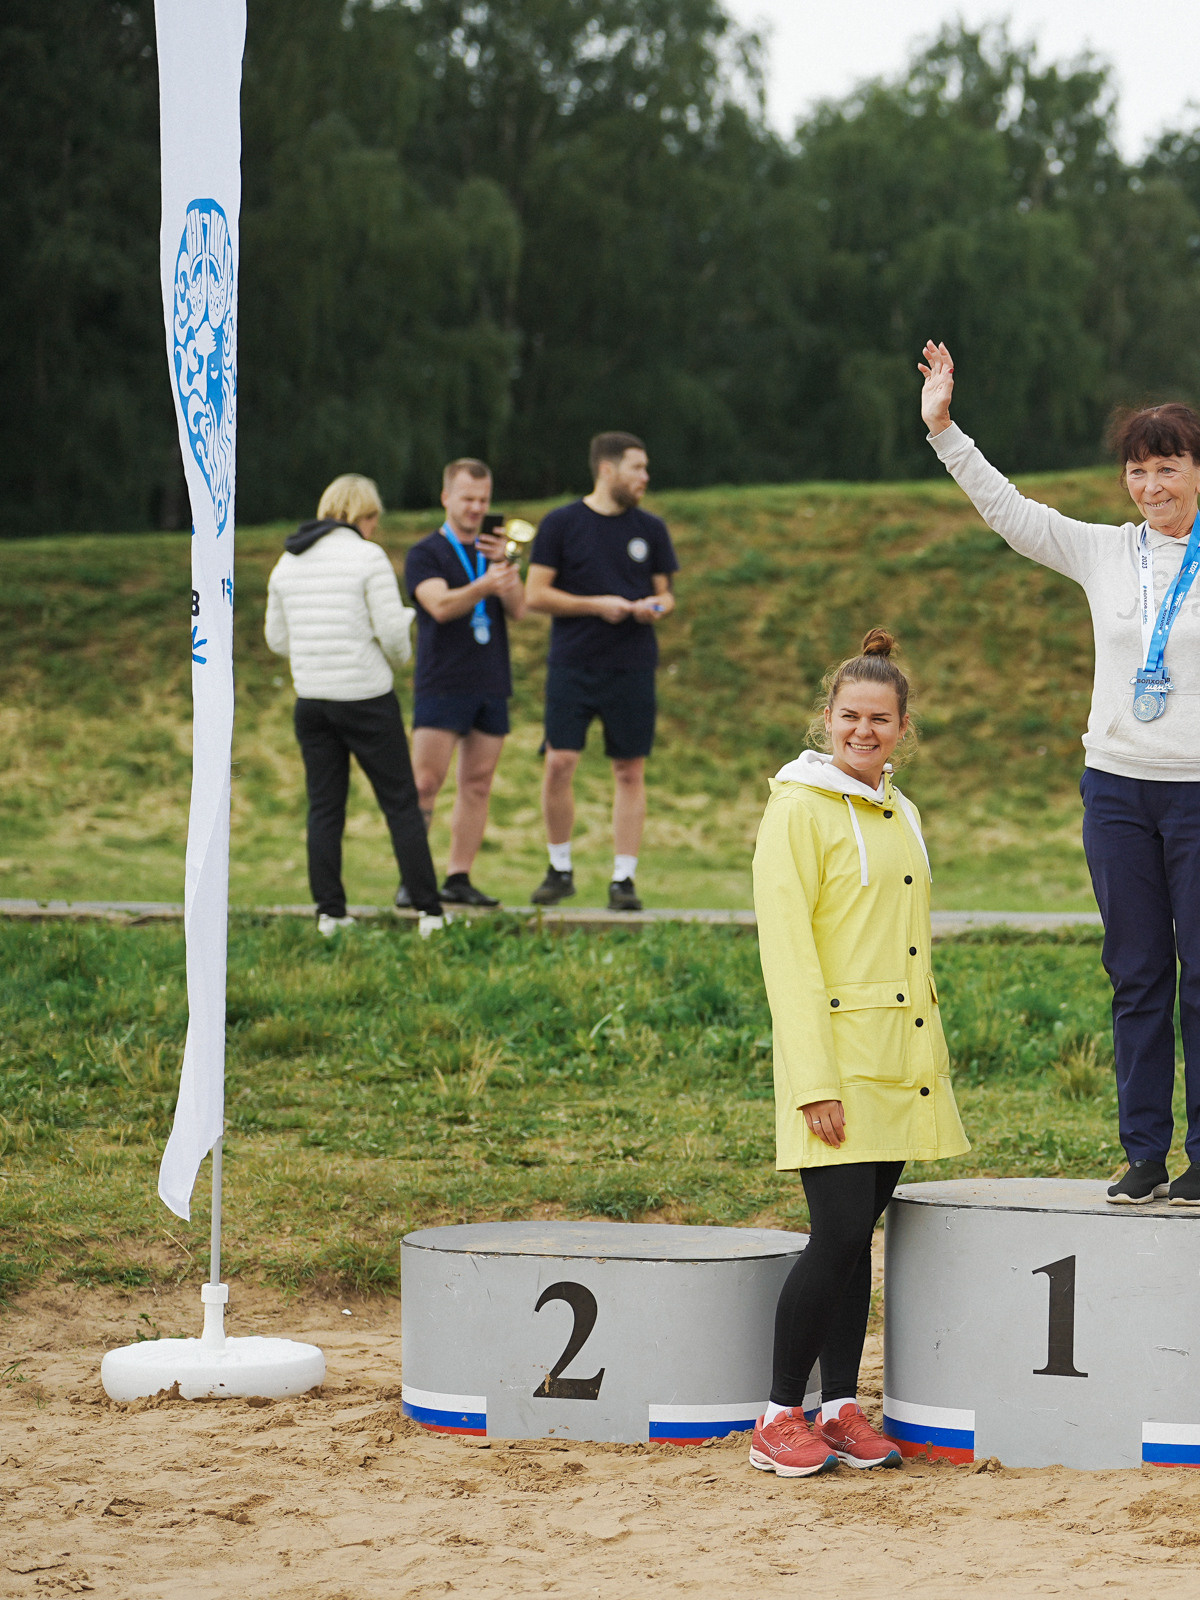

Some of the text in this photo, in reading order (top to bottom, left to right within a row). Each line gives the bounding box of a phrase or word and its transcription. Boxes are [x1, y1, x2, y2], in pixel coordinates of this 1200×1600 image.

[1188, 561, 1199, 575] 2023
[533, 1281, 606, 1400] 2
[1032, 1255, 1089, 1378] 1
